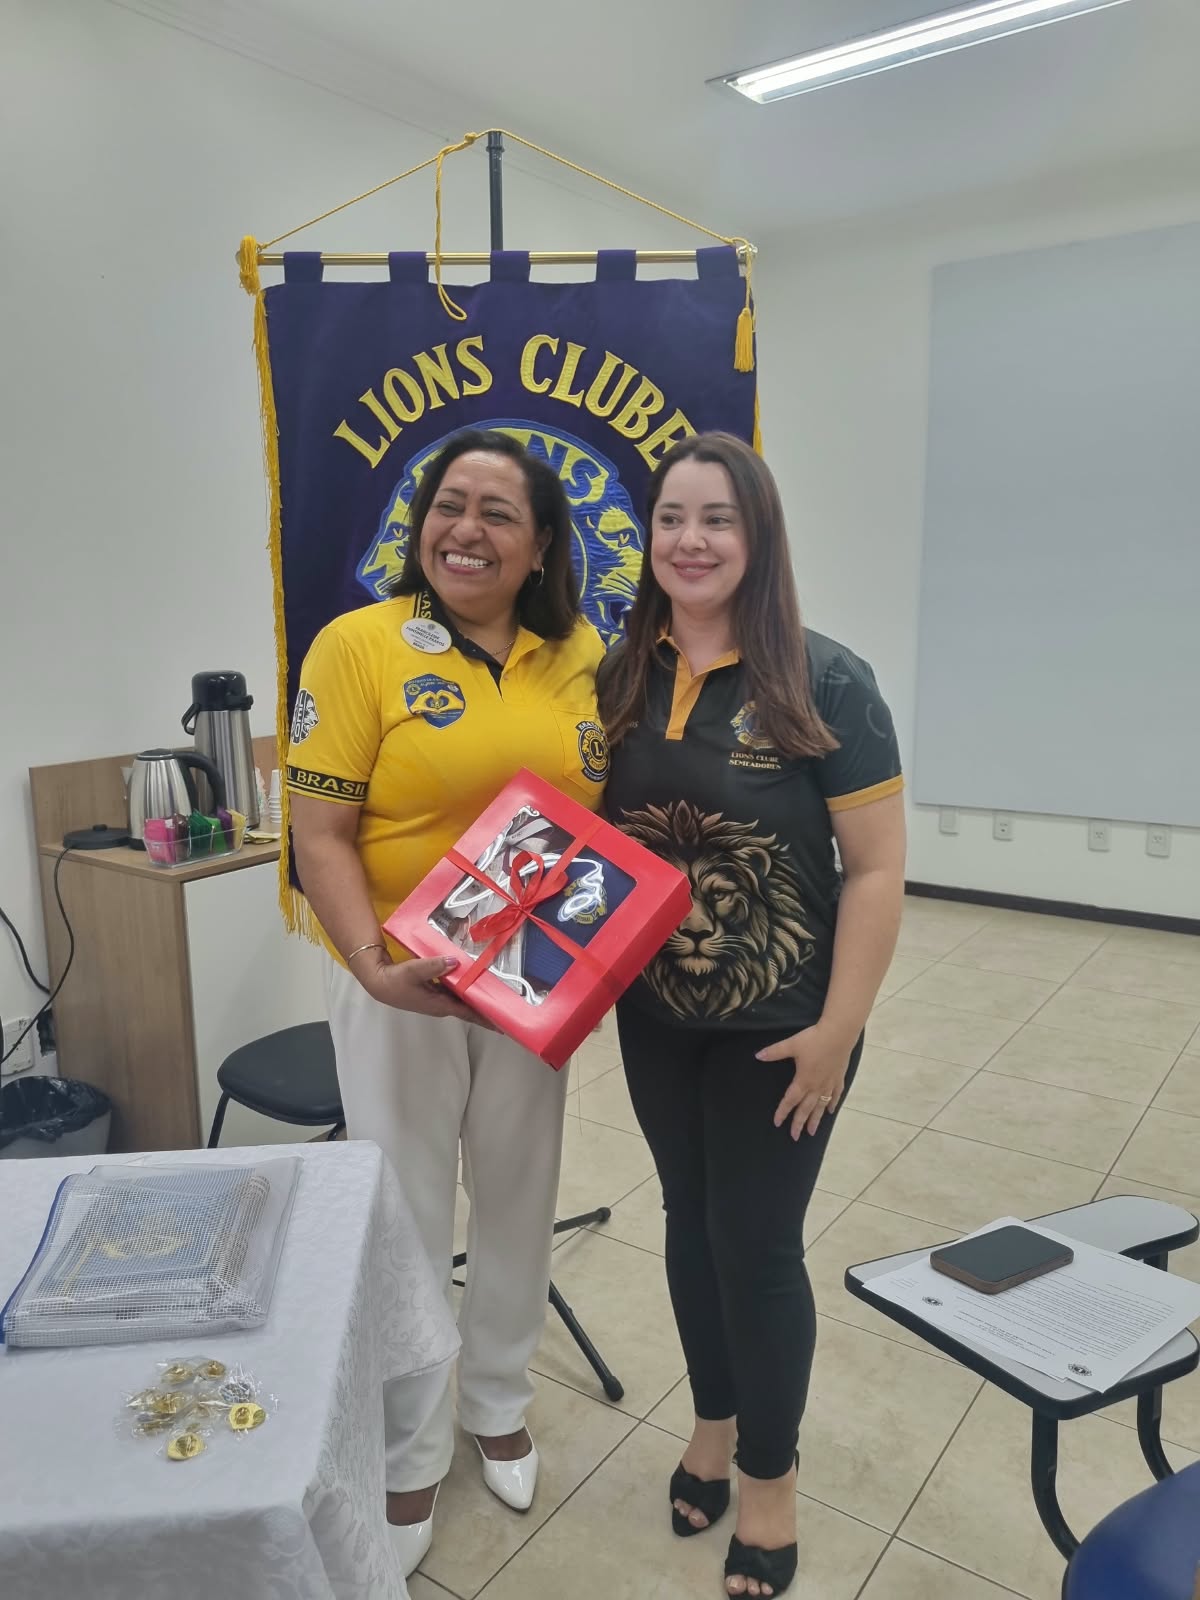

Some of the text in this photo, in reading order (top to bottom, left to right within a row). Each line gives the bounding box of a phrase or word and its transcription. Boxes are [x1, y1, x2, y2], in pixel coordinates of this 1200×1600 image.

[333, 335, 493, 469] LIONS
[519, 334, 698, 472] CLUBE
[731, 751, 755, 760] LIONS
[296, 769, 367, 796] BRASIL
